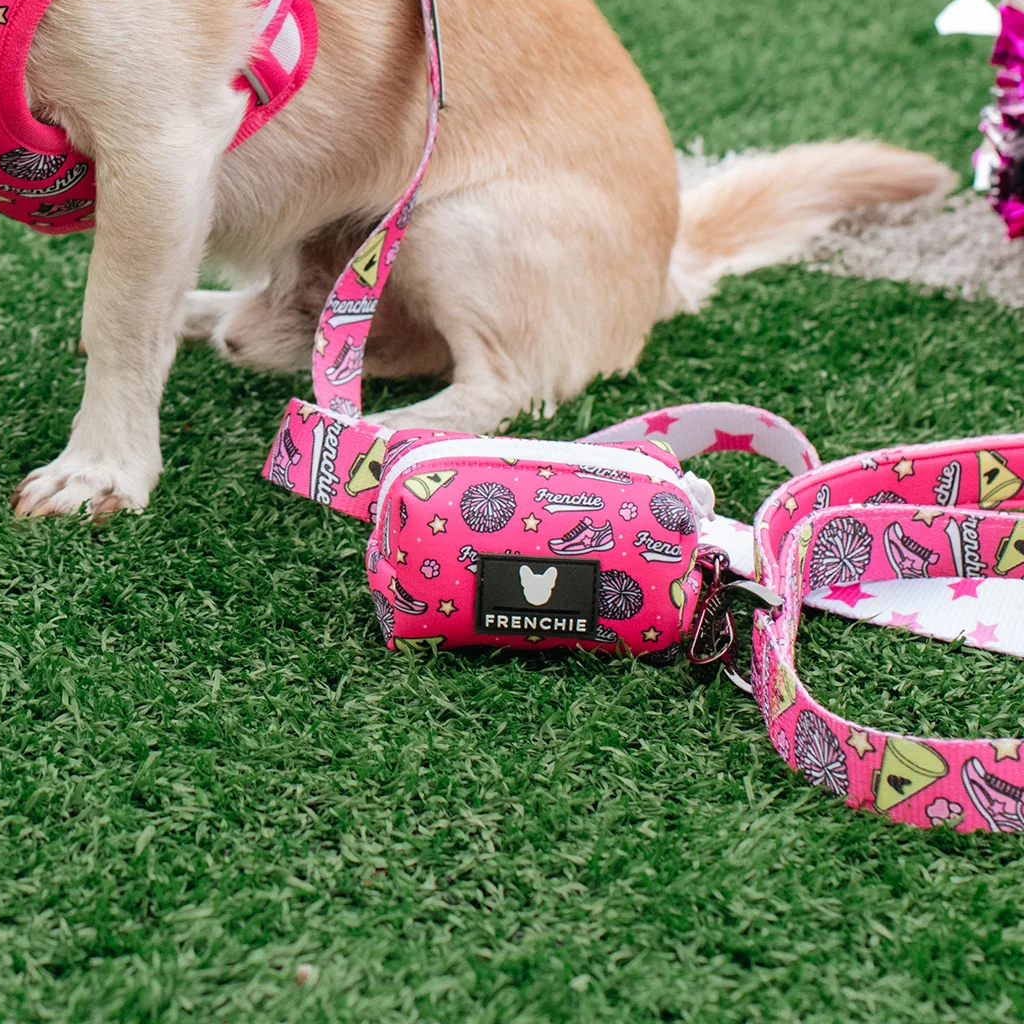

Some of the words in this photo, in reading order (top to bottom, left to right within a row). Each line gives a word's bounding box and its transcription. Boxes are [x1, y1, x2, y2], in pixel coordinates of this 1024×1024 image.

[316, 420, 350, 505] renchie
[534, 487, 605, 507] Frenchie
[633, 530, 682, 556] Frenc
[485, 614, 588, 633] FRENCHIE
